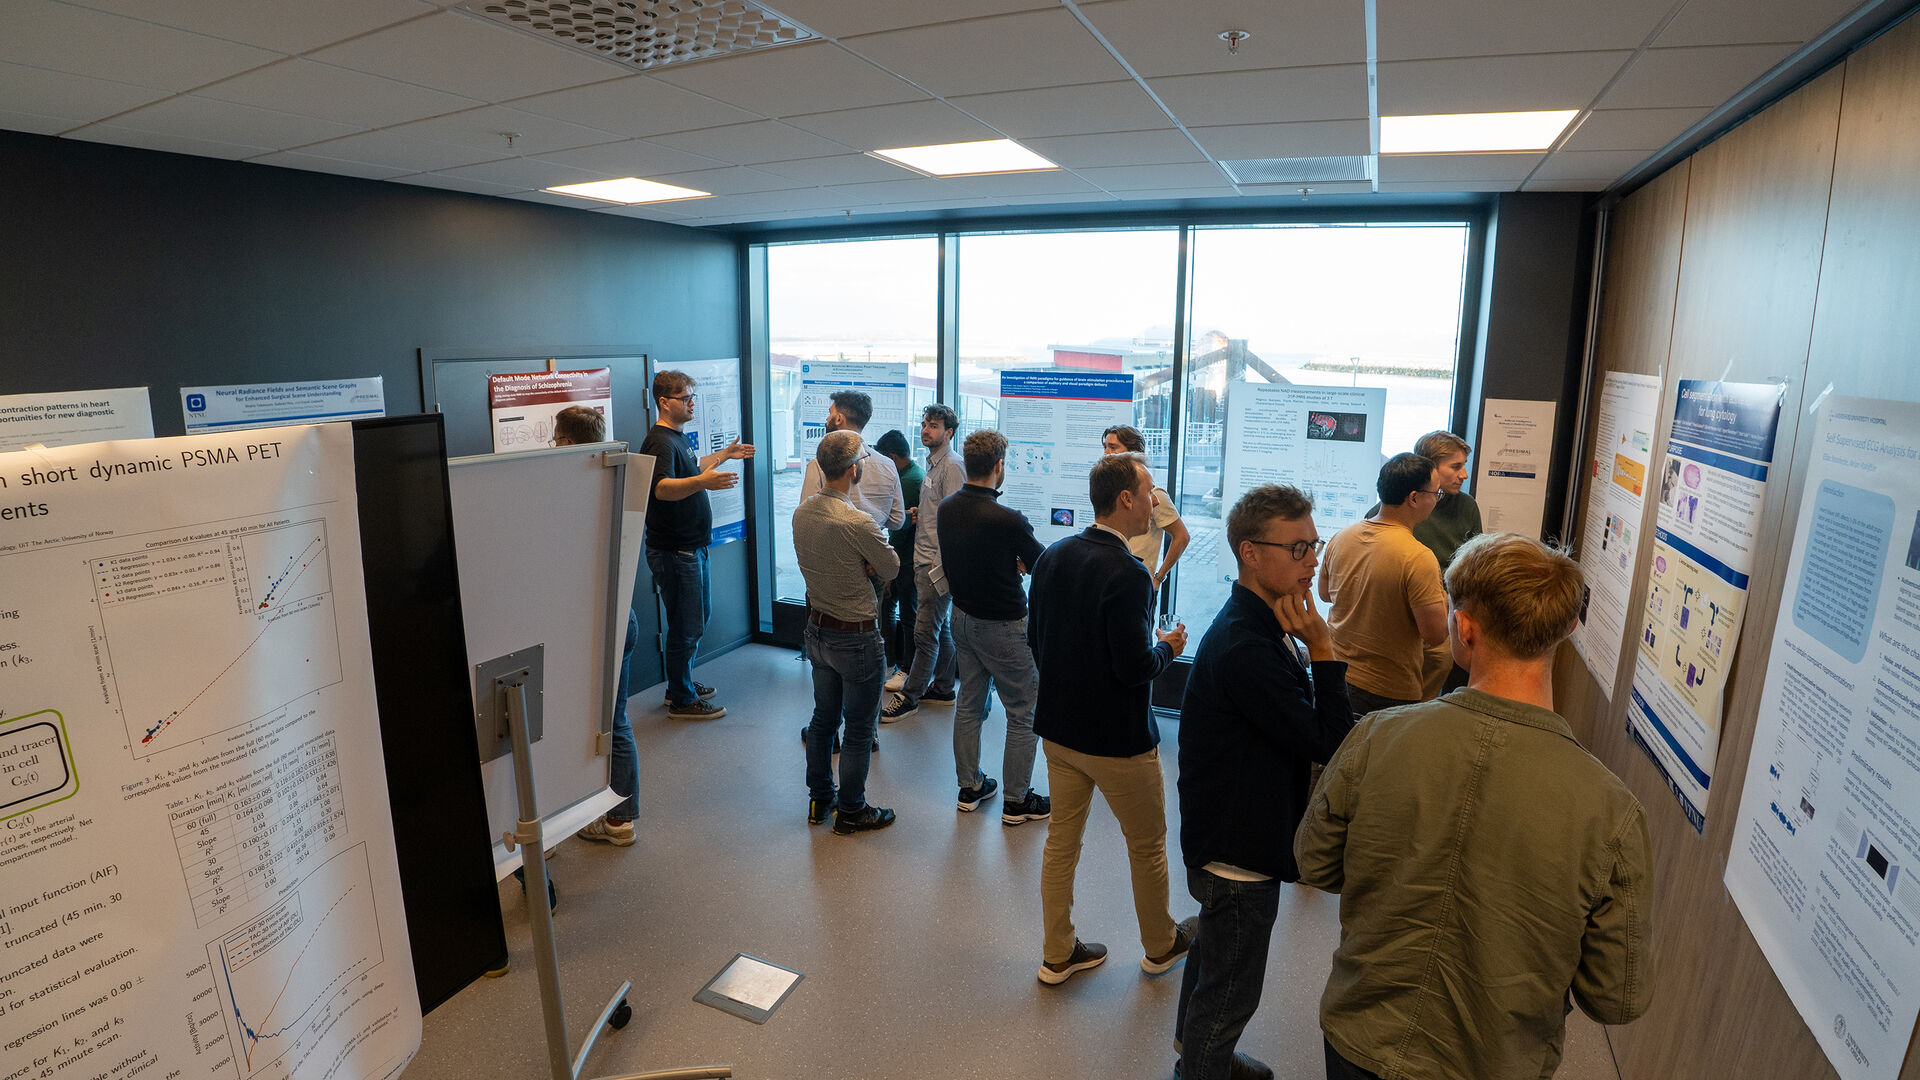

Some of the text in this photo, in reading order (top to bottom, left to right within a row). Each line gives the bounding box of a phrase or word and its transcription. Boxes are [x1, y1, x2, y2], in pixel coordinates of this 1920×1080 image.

[505, 384, 531, 392] Diagnosis
[539, 381, 572, 390] Schizophrenia
[47, 403, 79, 412] patterns
[77, 409, 114, 417] diagnostic
[1716, 410, 1736, 424] cytology
[21, 467, 78, 486] short
[90, 455, 172, 481] dynamic
[181, 447, 239, 468] PSMA
[246, 442, 281, 460] PET
[1, 502, 49, 520] ents
[62, 534, 87, 542] University
[95, 529, 114, 537] Norway
[146, 538, 181, 548] Comparison
[132, 554, 148, 562] points
[21, 736, 57, 752] tracer
[121, 781, 143, 792] Figure
[201, 755, 220, 764] values
[221, 749, 234, 757] from
[235, 744, 244, 752] the
[246, 738, 255, 747] full
[285, 717, 303, 729] compared
[2, 755, 39, 774] in cell
[124, 779, 171, 801] corresponding
[172, 774, 192, 784] values
[193, 768, 208, 776] from
[221, 751, 248, 766] truncated
[166, 801, 184, 810] Table
[171, 794, 224, 821] Duration [min]
[19, 814, 75, 839] are the arterial
[187, 813, 217, 830] 60 (full)
[0, 819, 93, 856] curves, respectively. Net
[200, 828, 210, 836] 45
[196, 836, 217, 848] Slope
[208, 858, 217, 866] 30
[204, 866, 224, 878] Slope
[9, 864, 118, 915] input function (AIF)
[215, 887, 223, 895] 15
[211, 895, 231, 907] Slope
[4, 892, 122, 949] truncated (45 min, 30
[248, 906, 286, 934] AIF scan
[249, 931, 261, 941] TAC
[251, 929, 278, 948] Prediction
[52, 932, 104, 959] data were
[253, 936, 279, 956] Prediction
[9, 947, 138, 1011] for statistical evaluation.
[185, 963, 207, 979] 50000
[192, 987, 212, 1002] 40000
[4, 980, 133, 1051] regression lines was 0.90
[199, 1011, 219, 1027] 30000
[33, 1021, 110, 1068] for and
[205, 1034, 224, 1050] 20000
[40, 1033, 122, 1079] 45 minute scan.
[110, 1048, 148, 1074] without
[211, 1056, 230, 1073] 10000
[127, 1053, 159, 1078] clinical
[166, 1069, 181, 1080] the
